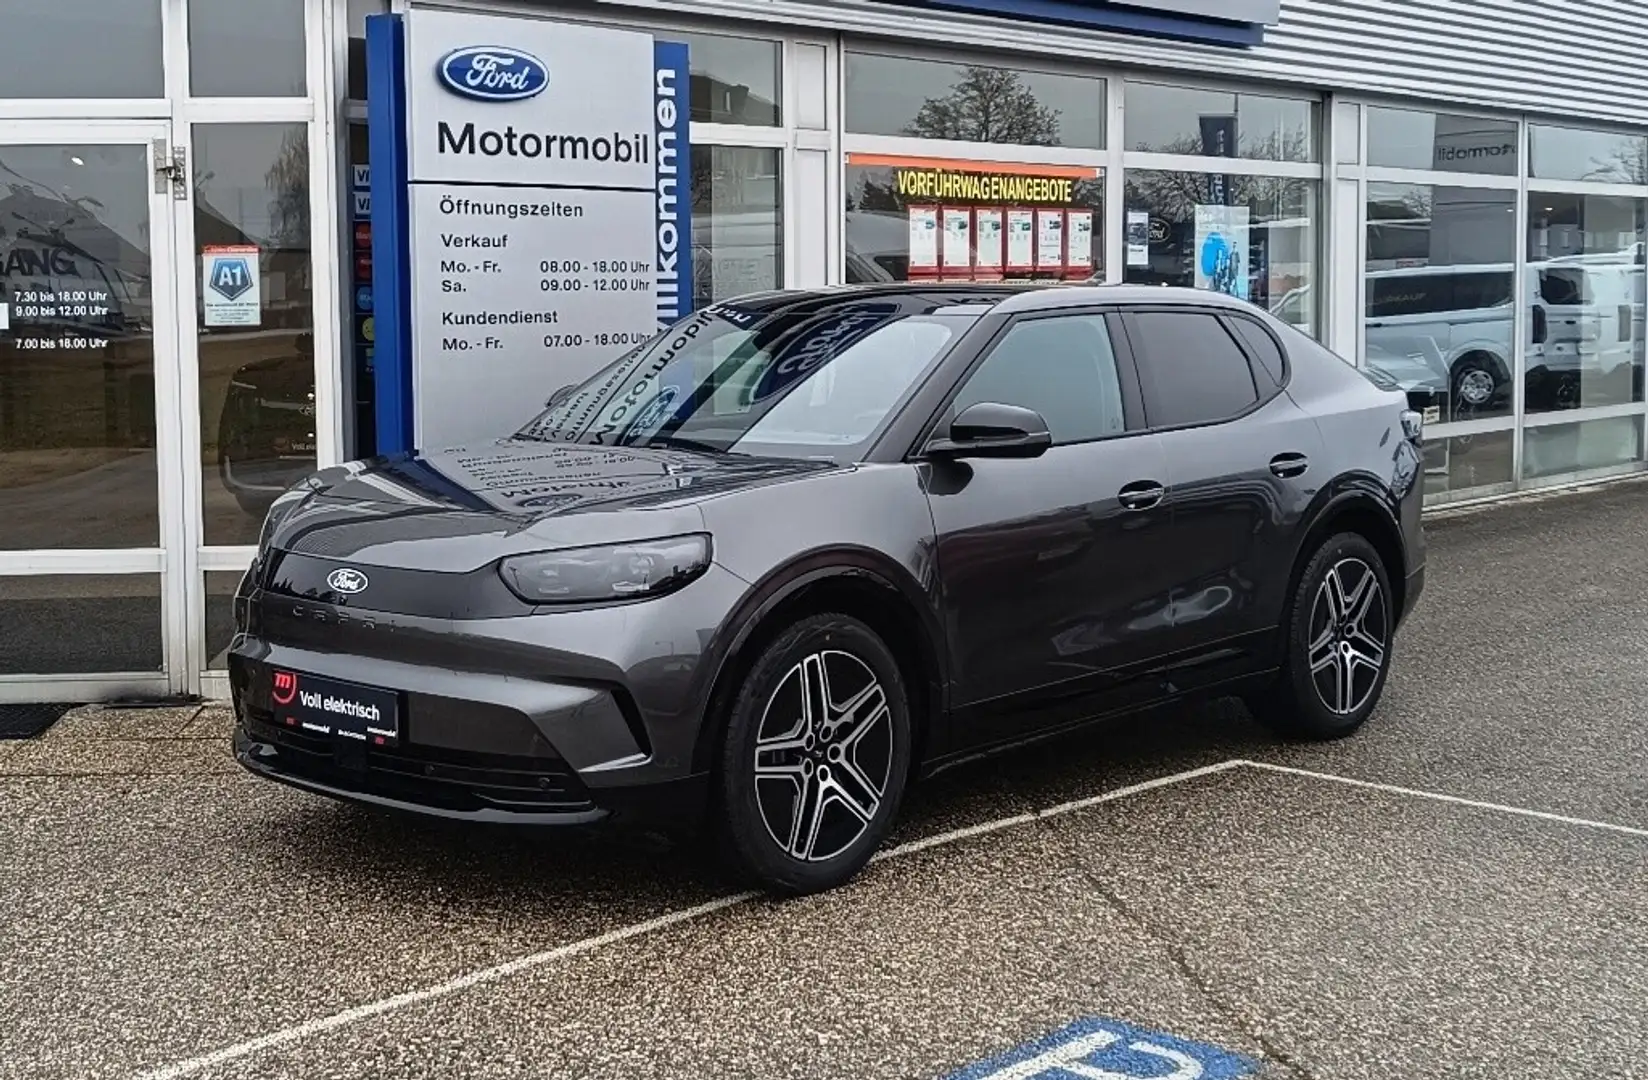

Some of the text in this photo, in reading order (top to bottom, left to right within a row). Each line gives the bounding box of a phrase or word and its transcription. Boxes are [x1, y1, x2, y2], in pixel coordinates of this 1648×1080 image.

[465, 54, 530, 90] Ford
[438, 121, 649, 164] Motormobil
[898, 168, 1072, 202] VORFÜHRWAGENANGEBOTE
[440, 195, 583, 219] Öffnungszeiten
[441, 234, 509, 248] Verkauf
[0, 248, 77, 276] ANG
[441, 260, 471, 272] Mo.
[483, 261, 502, 272] Fr.
[540, 261, 581, 273] 08.00
[593, 261, 628, 273] 18.00
[631, 262, 650, 273] Uhr
[218, 265, 242, 287] A1
[442, 280, 467, 293] Sa.
[540, 279, 581, 291] 09.00
[594, 279, 628, 291] 12.00
[631, 280, 650, 291] Uhr
[15, 291, 108, 302] 7.30 bis 18.00 Uhr
[16, 305, 109, 317] 9.00 bis 12.00 Uhr
[442, 310, 558, 325] Kundendienst
[15, 337, 109, 349] 7.00 bis 18.00 Uhr
[443, 338, 472, 350] Mo.
[485, 337, 503, 349] Fr.
[544, 335, 582, 347] 07.00
[595, 334, 629, 346] 18.00
[631, 333, 652, 345] Uhr
[300, 690, 381, 721] Voll elektrisch
